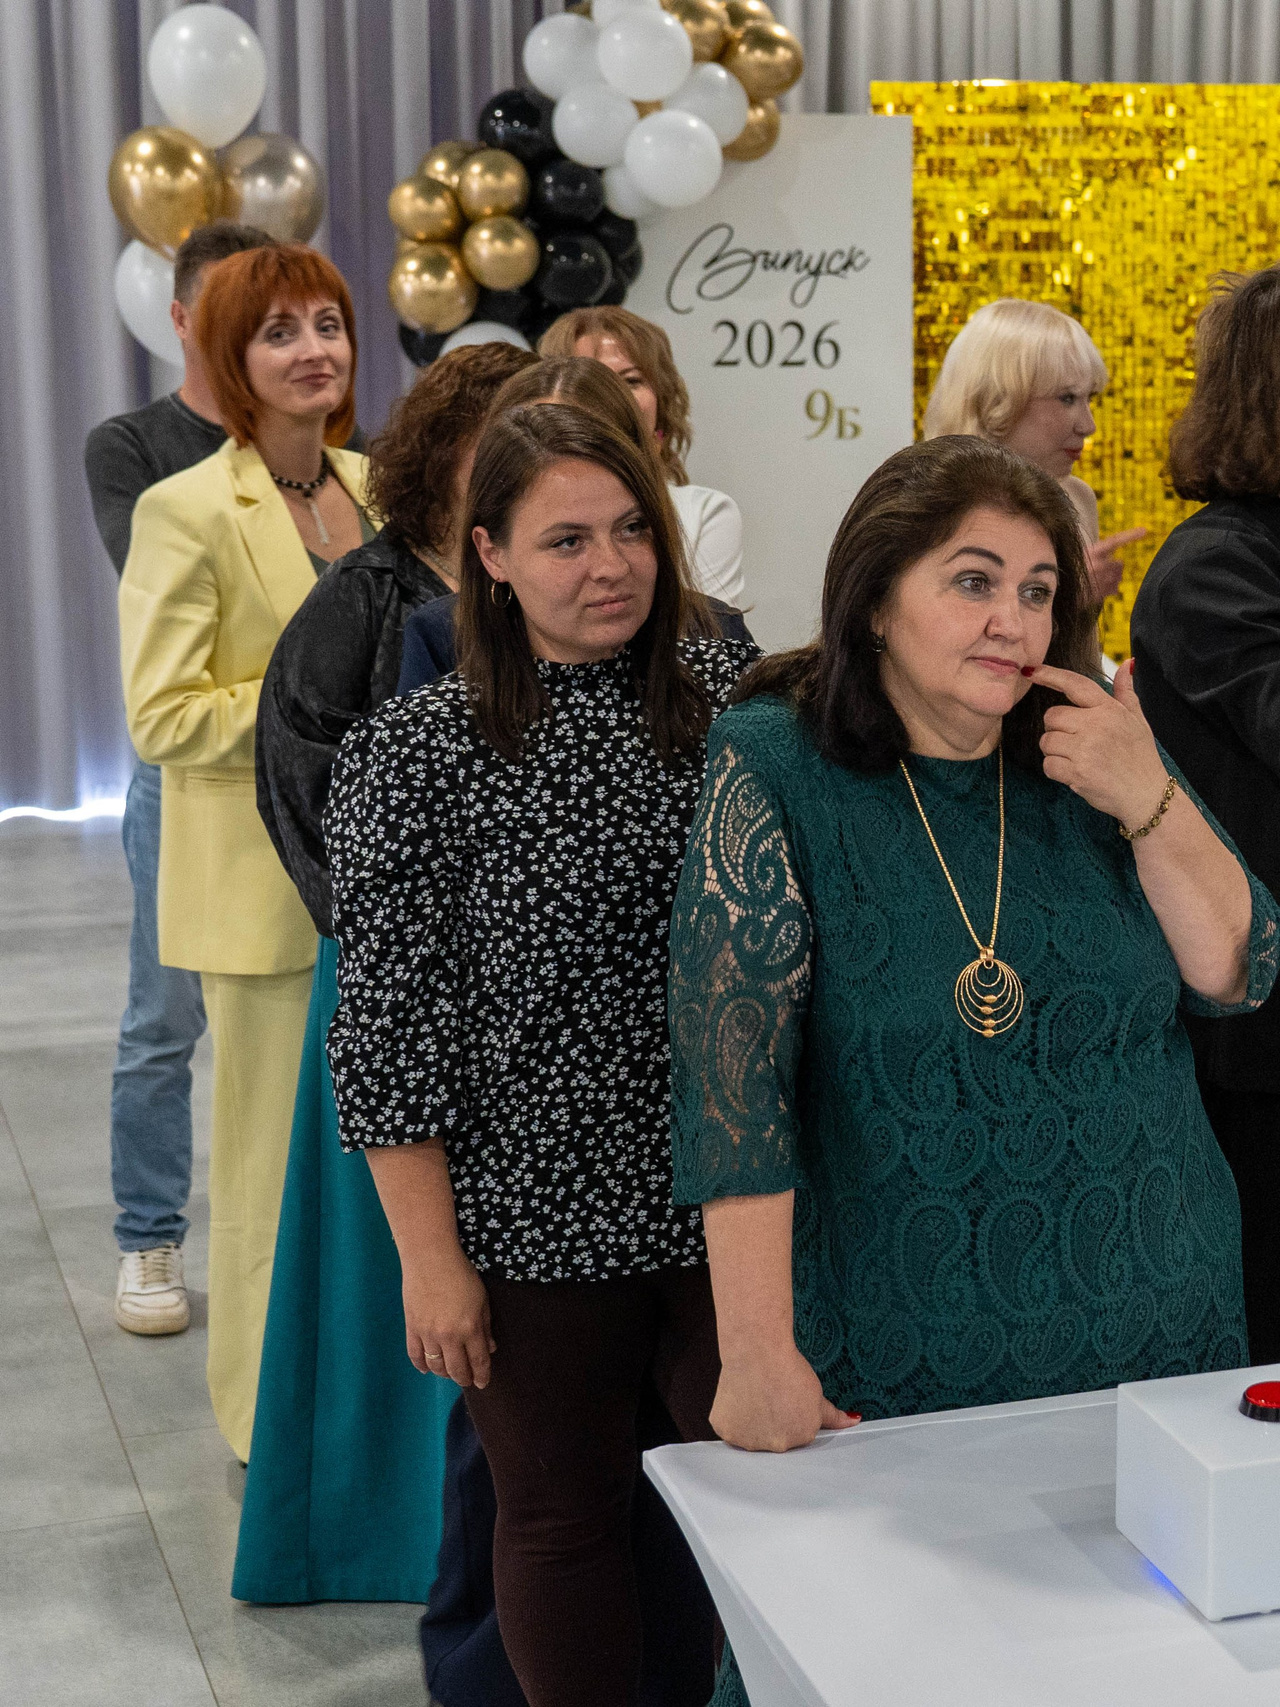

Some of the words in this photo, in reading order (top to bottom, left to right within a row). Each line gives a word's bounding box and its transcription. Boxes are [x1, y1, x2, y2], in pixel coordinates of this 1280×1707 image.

[666, 223, 870, 314] Випуск
[712, 319, 840, 369] 2026
[804, 388, 862, 440] 9Б
